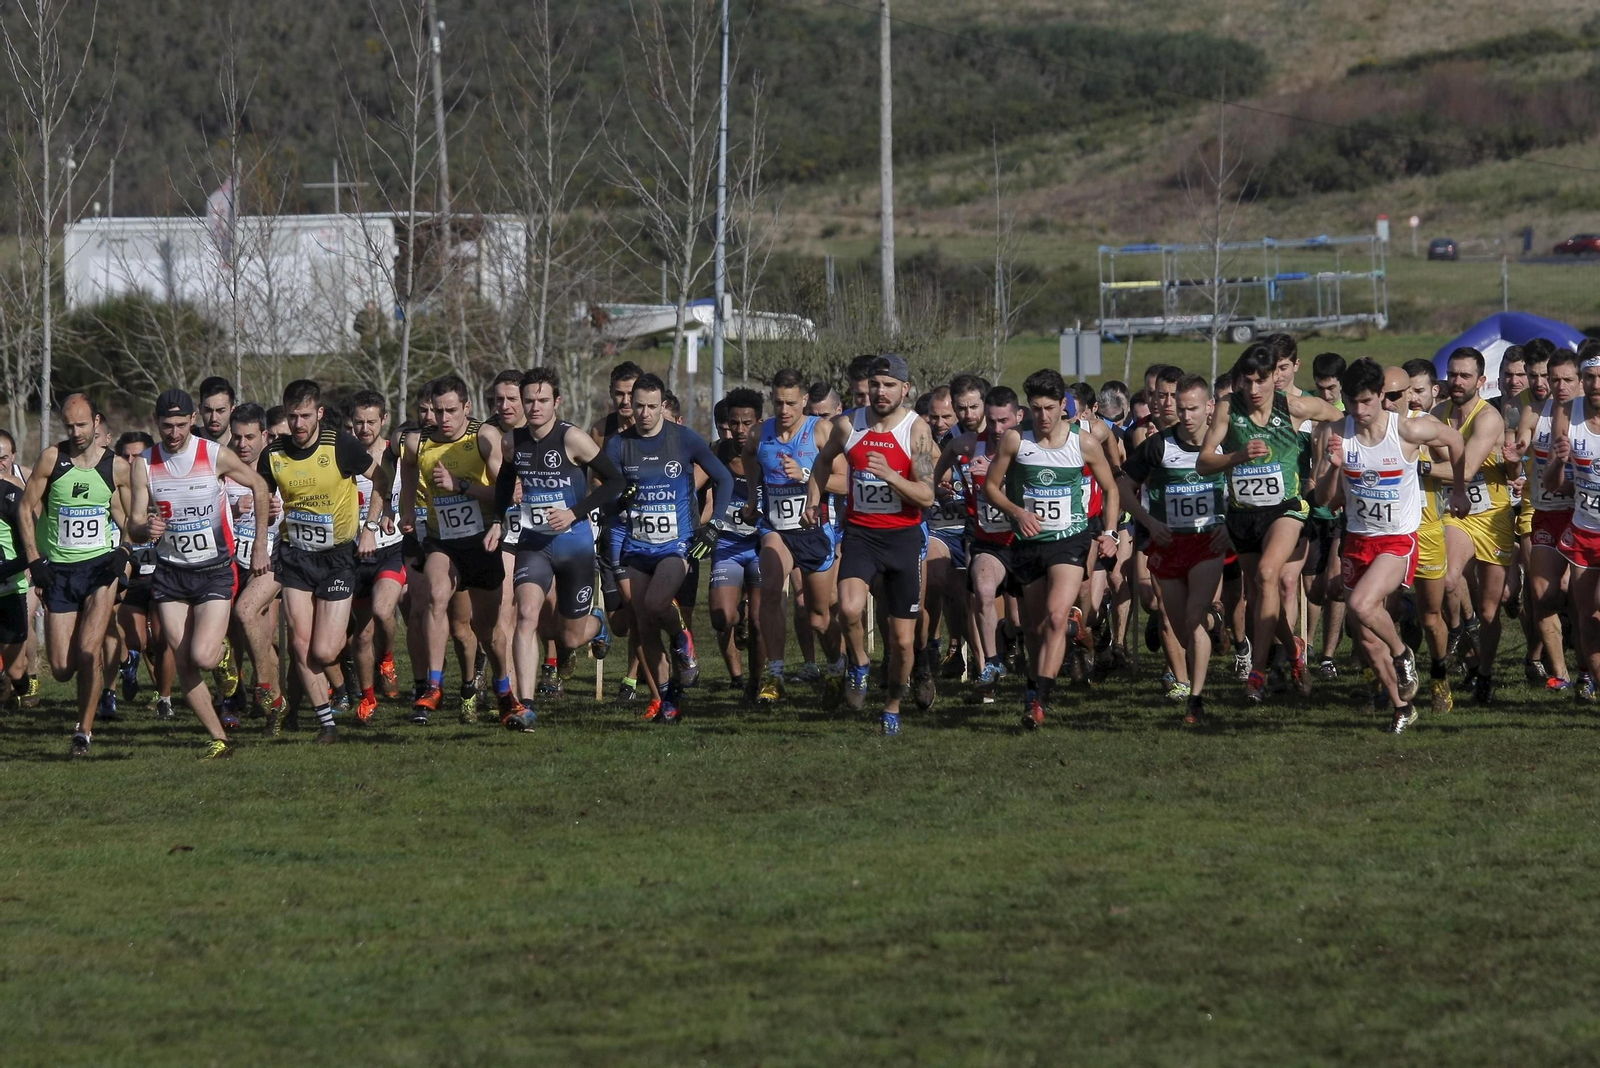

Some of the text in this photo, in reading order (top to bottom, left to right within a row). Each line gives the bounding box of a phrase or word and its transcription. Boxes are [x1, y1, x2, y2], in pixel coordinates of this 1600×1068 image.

[869, 440, 894, 449] BARCO
[1243, 465, 1271, 475] PONTES
[1272, 463, 1281, 471] 19
[523, 476, 571, 488] ARÓN
[861, 472, 877, 480] PON
[289, 478, 316, 487] EDENTE
[1176, 484, 1205, 493] PONTES
[1236, 477, 1280, 497] 228
[635, 489, 676, 501] ARÓN
[775, 486, 801, 495] PONTES
[856, 484, 893, 504] 123
[1034, 488, 1063, 496] PONTES
[1063, 487, 1071, 495] 19
[1361, 488, 1390, 499] PONTES
[440, 494, 467, 505] PONTES
[528, 493, 553, 502] PONTES
[554, 492, 564, 500] 19
[1578, 491, 1600, 514] 24
[69, 507, 97, 516] PONTES
[98, 506, 106, 514] 19
[773, 497, 807, 520] 197
[1169, 496, 1209, 517] 166
[1356, 499, 1392, 523] 241
[296, 512, 323, 522] PONTES
[439, 505, 476, 529] 162
[63, 519, 99, 538] 139
[173, 522, 201, 532] PONTES
[634, 515, 671, 534] 168
[291, 522, 327, 544] 159
[169, 533, 209, 554] 120
[327, 583, 350, 594] EDENTE
